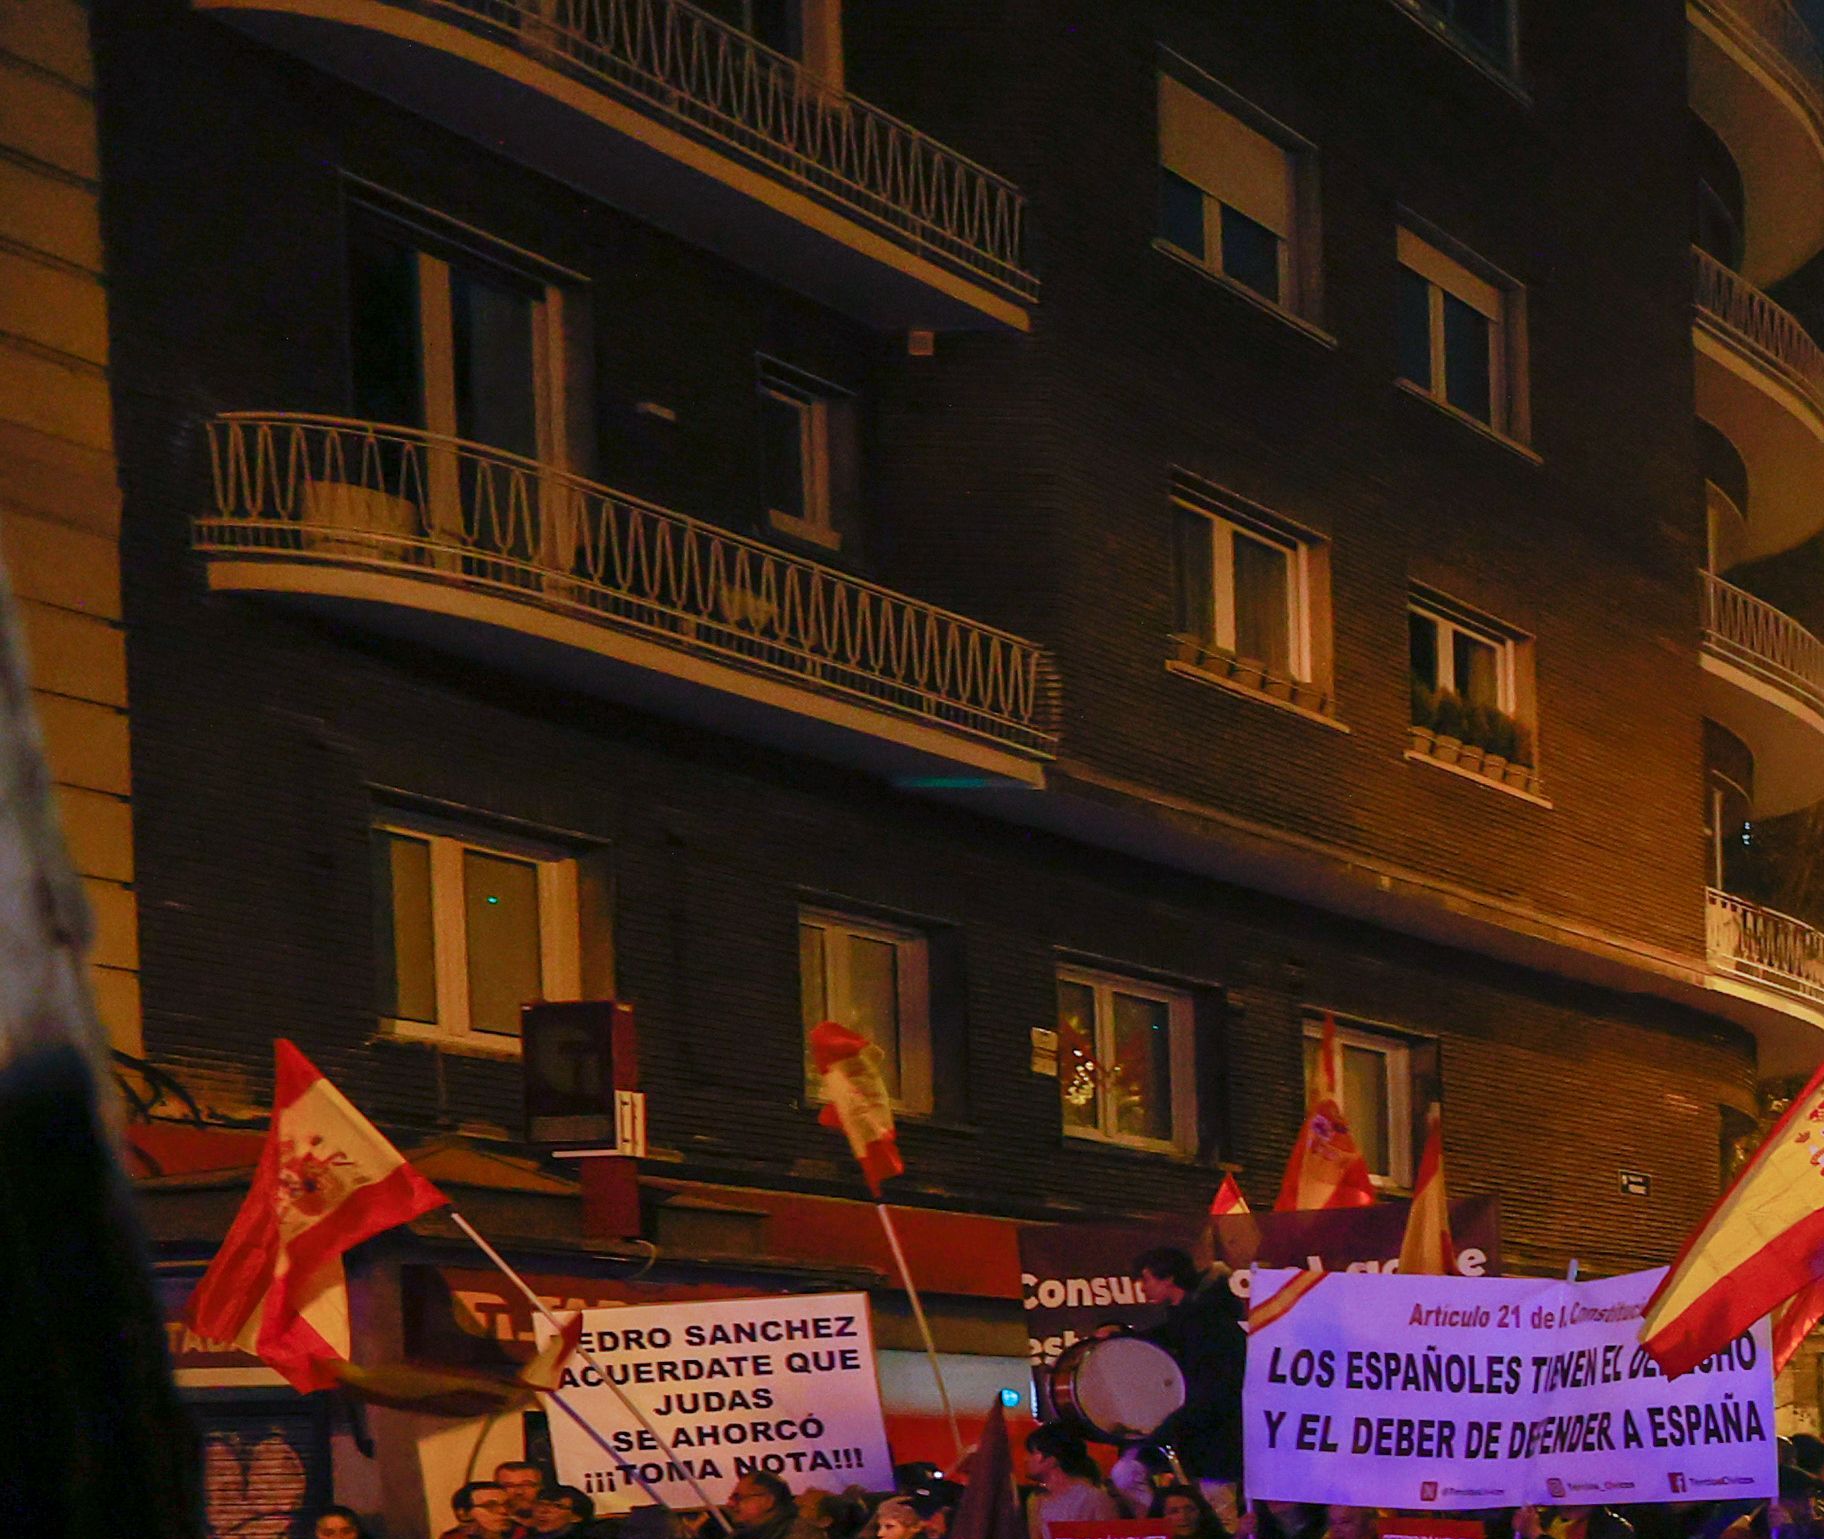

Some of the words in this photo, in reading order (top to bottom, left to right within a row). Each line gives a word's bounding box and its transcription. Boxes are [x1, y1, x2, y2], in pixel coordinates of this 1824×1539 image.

[578, 1327, 672, 1354] EDRO
[685, 1316, 857, 1343] SANCHEZ
[1497, 1303, 1521, 1329] 21
[1531, 1305, 1554, 1330] de
[560, 1354, 773, 1389] ACUERDATE
[785, 1349, 861, 1374] QUE
[1267, 1346, 1335, 1389] LOS
[1345, 1344, 1521, 1395] ESPAÑOLES
[1602, 1344, 1624, 1383] EL
[1628, 1330, 1756, 1379] DEHO
[654, 1388, 774, 1416] JUDAS
[613, 1429, 660, 1453] SE
[672, 1413, 825, 1449] AHORCÓ
[1263, 1409, 1287, 1450] Y
[1298, 1413, 1339, 1454] EL
[1351, 1415, 1455, 1459] DEBER
[1464, 1418, 1499, 1460] DE
[1623, 1409, 1644, 1449] A
[1647, 1392, 1767, 1448] ESPAÑA
[584, 1460, 723, 1494] ¡¡¡TOMA
[733, 1447, 865, 1478] NOTA!!!
